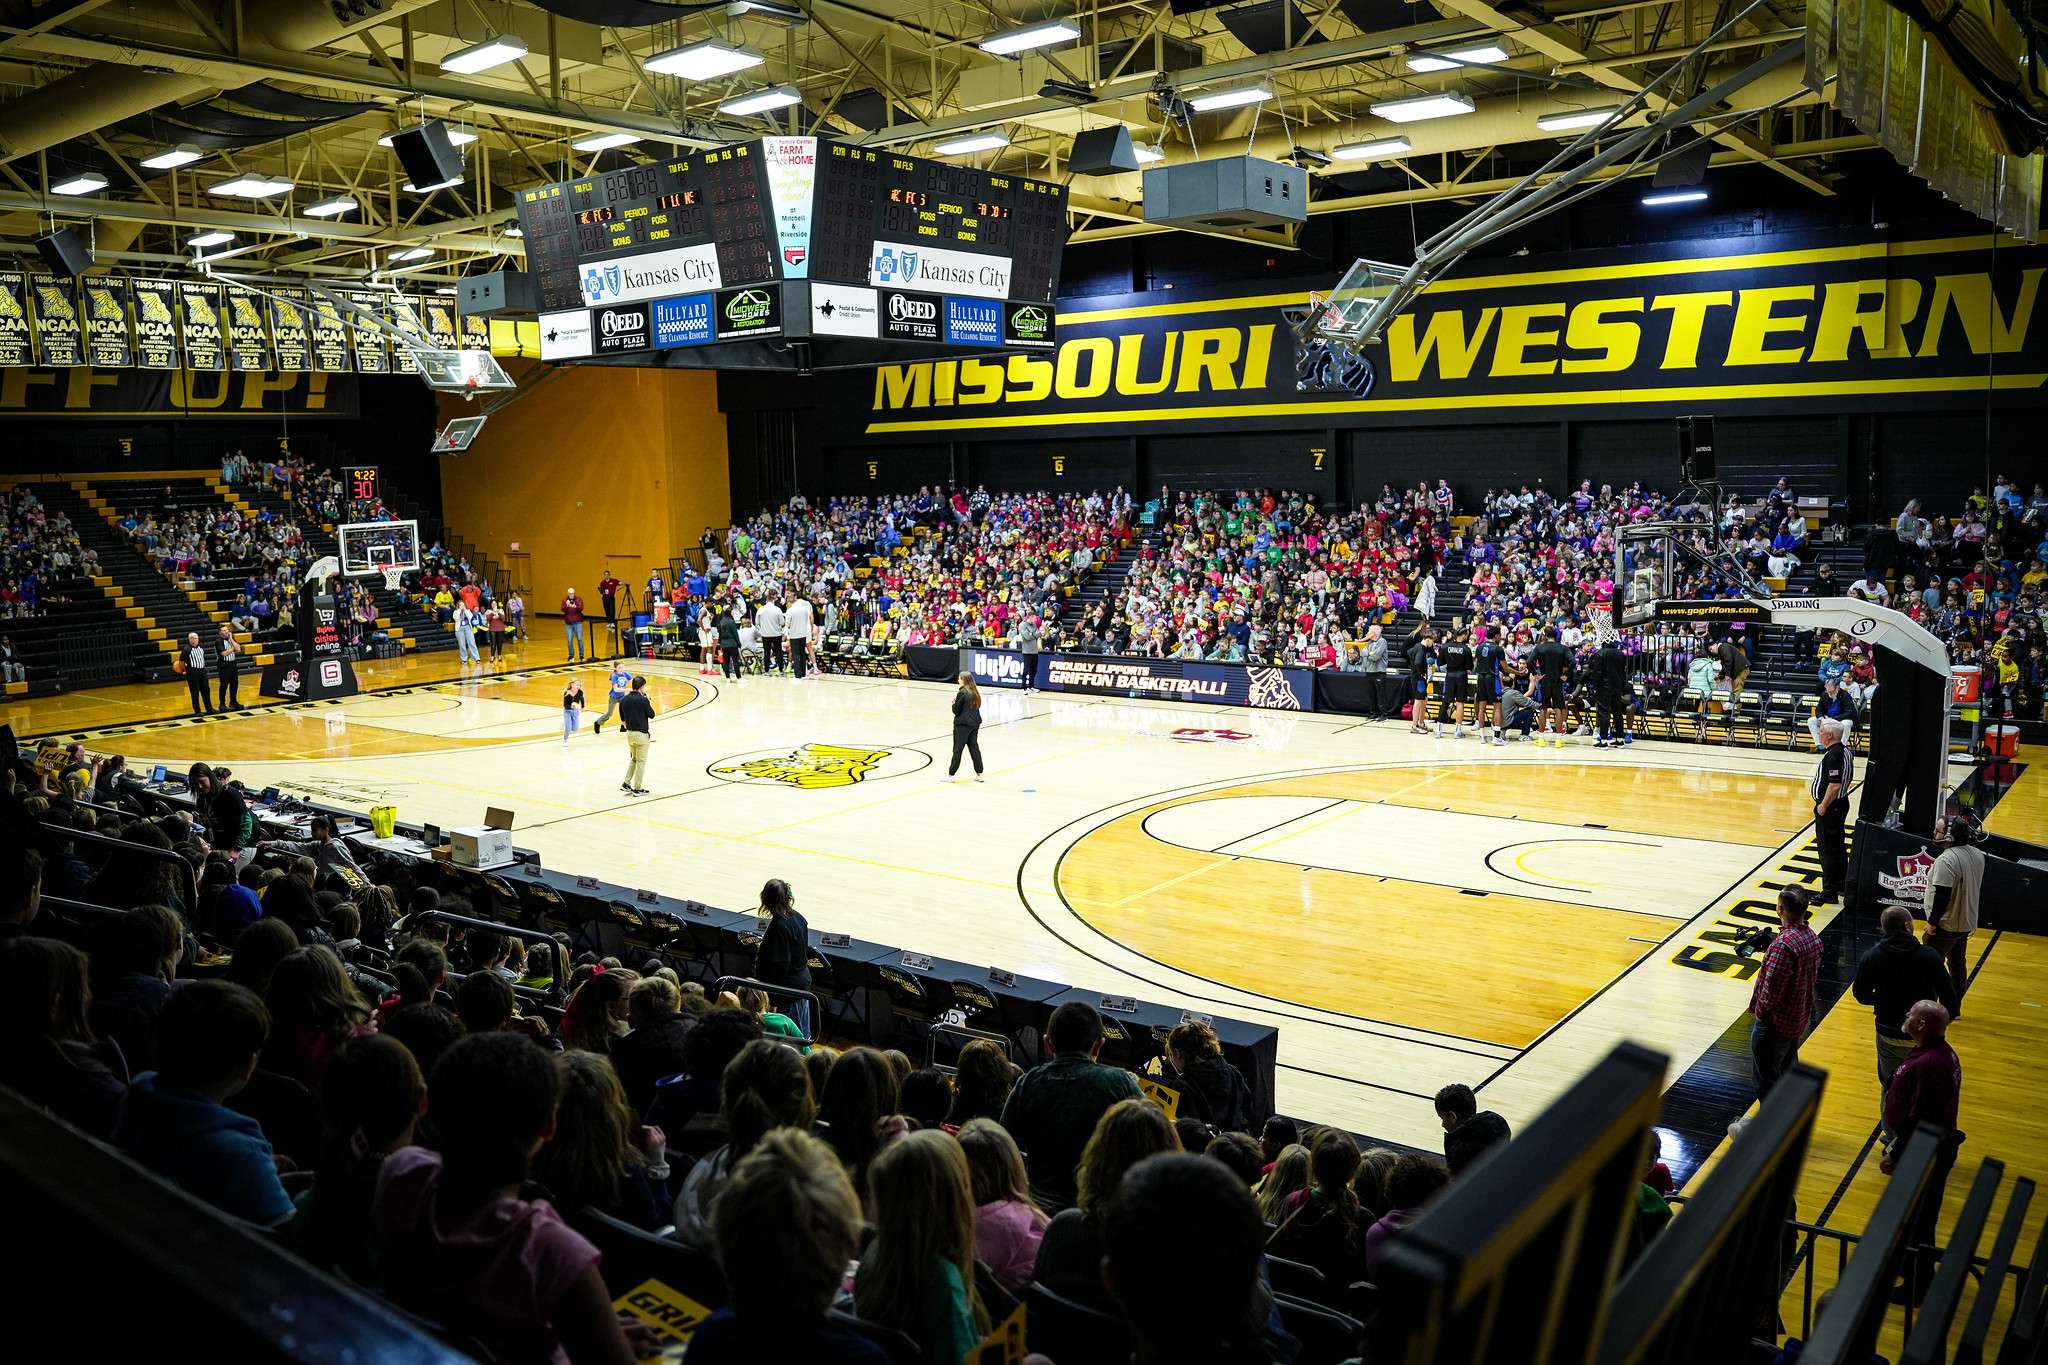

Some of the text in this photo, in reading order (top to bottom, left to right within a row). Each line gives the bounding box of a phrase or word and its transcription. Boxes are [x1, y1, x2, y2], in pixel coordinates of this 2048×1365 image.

[722, 150, 732, 160] FLS
[779, 145, 803, 155] FARM
[833, 146, 876, 162] PLYR FLS PTS
[788, 155, 814, 165] HOME
[893, 160, 914, 171] TM FLS
[667, 162, 689, 174] TM FLS
[999, 180, 1009, 189] FLS
[624, 207, 649, 219] PERIOD
[938, 203, 963, 215] PERIOD
[651, 214, 668, 225] POSS
[919, 211, 936, 221] POSS
[610, 222, 626, 232] POSS
[962, 217, 978, 228] POSS
[650, 229, 670, 240] BONUS
[918, 226, 938, 236] BONUS
[957, 231, 977, 242] BONUS
[612, 236, 632, 247] BONUS
[624, 259, 715, 289] Kansas City
[920, 259, 1008, 292] Kansas City
[657, 303, 707, 323] HILLYARD
[733, 303, 770, 314] MIDWEST
[889, 294, 936, 321] REED
[950, 302, 997, 322] HILLYARD
[741, 309, 770, 319] HOMES
[0, 318, 28, 331] CAA
[36, 319, 81, 332] NCAA
[87, 320, 129, 334] NCAA
[601, 310, 644, 337] REED
[890, 324, 937, 334] AUTO PLAZA
[1387, 267, 2048, 382] WESTERN
[136, 322, 176, 337] NCAA
[183, 325, 222, 339] NCAA
[229, 327, 267, 339] NCAA
[274, 328, 308, 340] NCAA
[313, 329, 347, 342] NCAA
[354, 331, 385, 344] NCAA
[461, 334, 490, 346] NCAA
[659, 334, 668, 343] THE
[951, 331, 960, 340] THE
[602, 339, 620, 348] AUTO
[623, 336, 645, 345] PLAZA
[50, 351, 72, 359] 23-8
[97, 352, 122, 360] 22-10
[148, 353, 167, 362] 20-9
[194, 356, 214, 364] 26-5
[282, 357, 301, 365] 23-7
[323, 358, 341, 366] 22-7
[873, 325, 1277, 411] MISSOURI
[122, 442, 131, 453] 3
[280, 440, 289, 450] 4
[1313, 452, 1323, 466] 7
[869, 464, 877, 476] 5
[1055, 459, 1063, 472] 6
[354, 470, 376, 481] 9:22
[353, 481, 373, 499] 30
[1771, 599, 1820, 610] SPALDING
[1661, 606, 1759, 617] www.gogriffons.com
[314, 633, 339, 643] aisles
[315, 642, 340, 651] online
[323, 664, 339, 679] G
[1049, 661, 1151, 677] PROUDLY SUPPORTS
[1049, 670, 1228, 697] GRIFFON BASKETBALL!
[1957, 677, 1967, 687] G
[1883, 876, 1913, 888] Rogers
